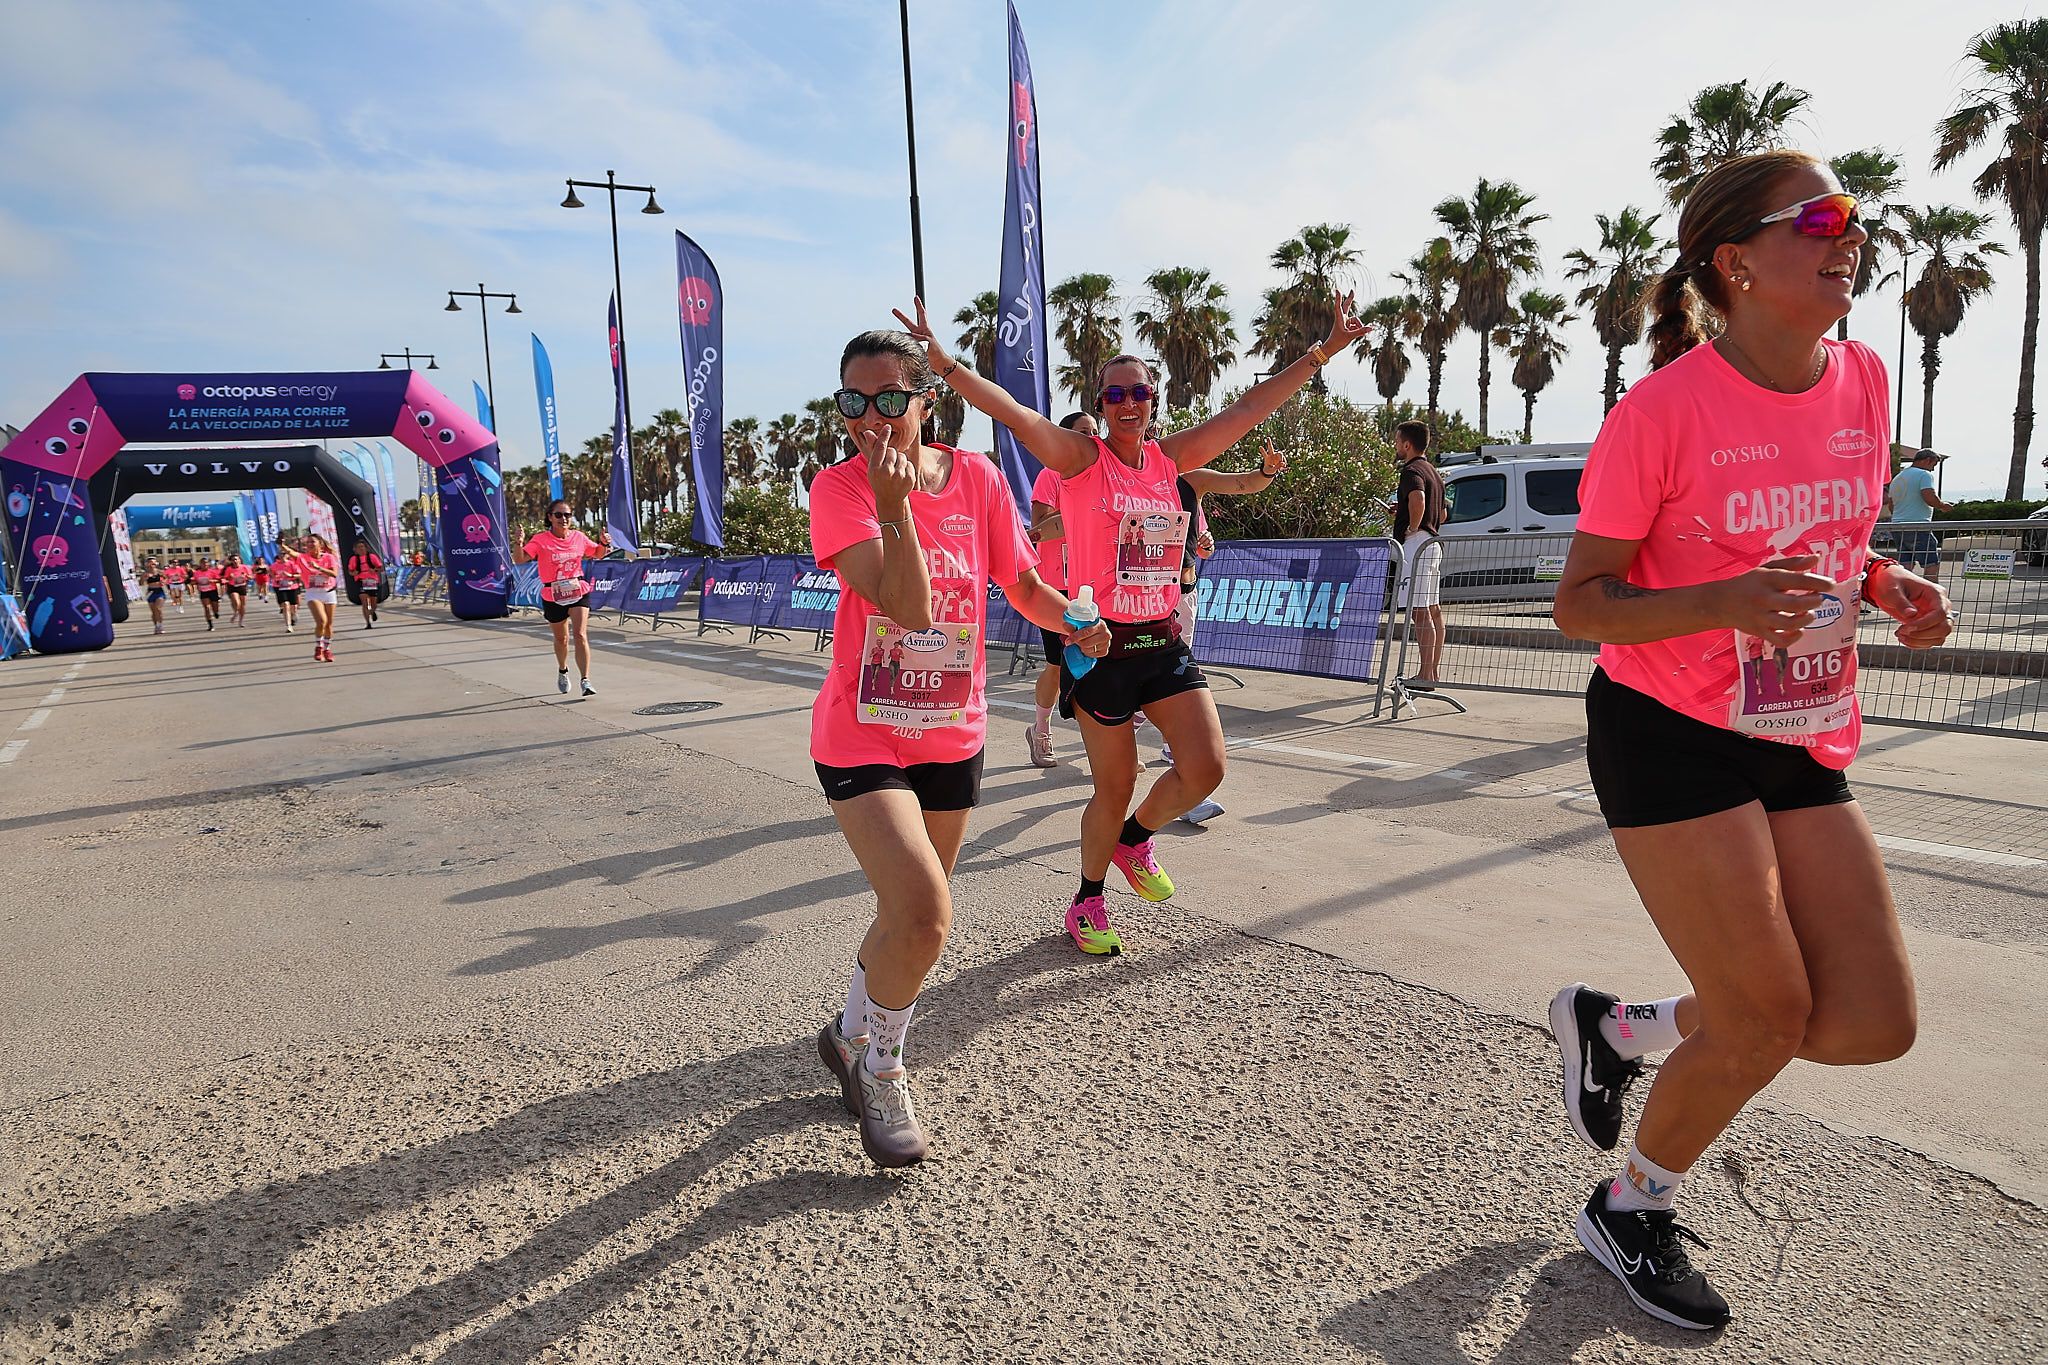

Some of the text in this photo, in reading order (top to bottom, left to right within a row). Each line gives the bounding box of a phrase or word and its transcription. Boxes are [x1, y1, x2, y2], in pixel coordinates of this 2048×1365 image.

[169, 405, 347, 418] LA ENERGÍA PARA CORRER
[168, 418, 350, 430] A LA VELOCIDAD DE LA LUZ
[1711, 443, 1780, 466] OYSHO
[144, 460, 291, 475] VOLVO
[1145, 545, 1164, 557] 016
[1112, 591, 1169, 617] MUJER
[1198, 578, 1350, 631] RABUENA!
[906, 635, 945, 647] ASTURIANA
[1124, 639, 1167, 650] HANKER
[1792, 650, 1842, 681] 016
[901, 670, 943, 689] 016
[1811, 682, 1828, 694] 634
[871, 697, 898, 706] CARRERA
[911, 692, 931, 700] 3017
[1758, 701, 1792, 712] CARRERA
[1805, 698, 1815, 706] LA
[1755, 716, 1808, 729] OYSHO
